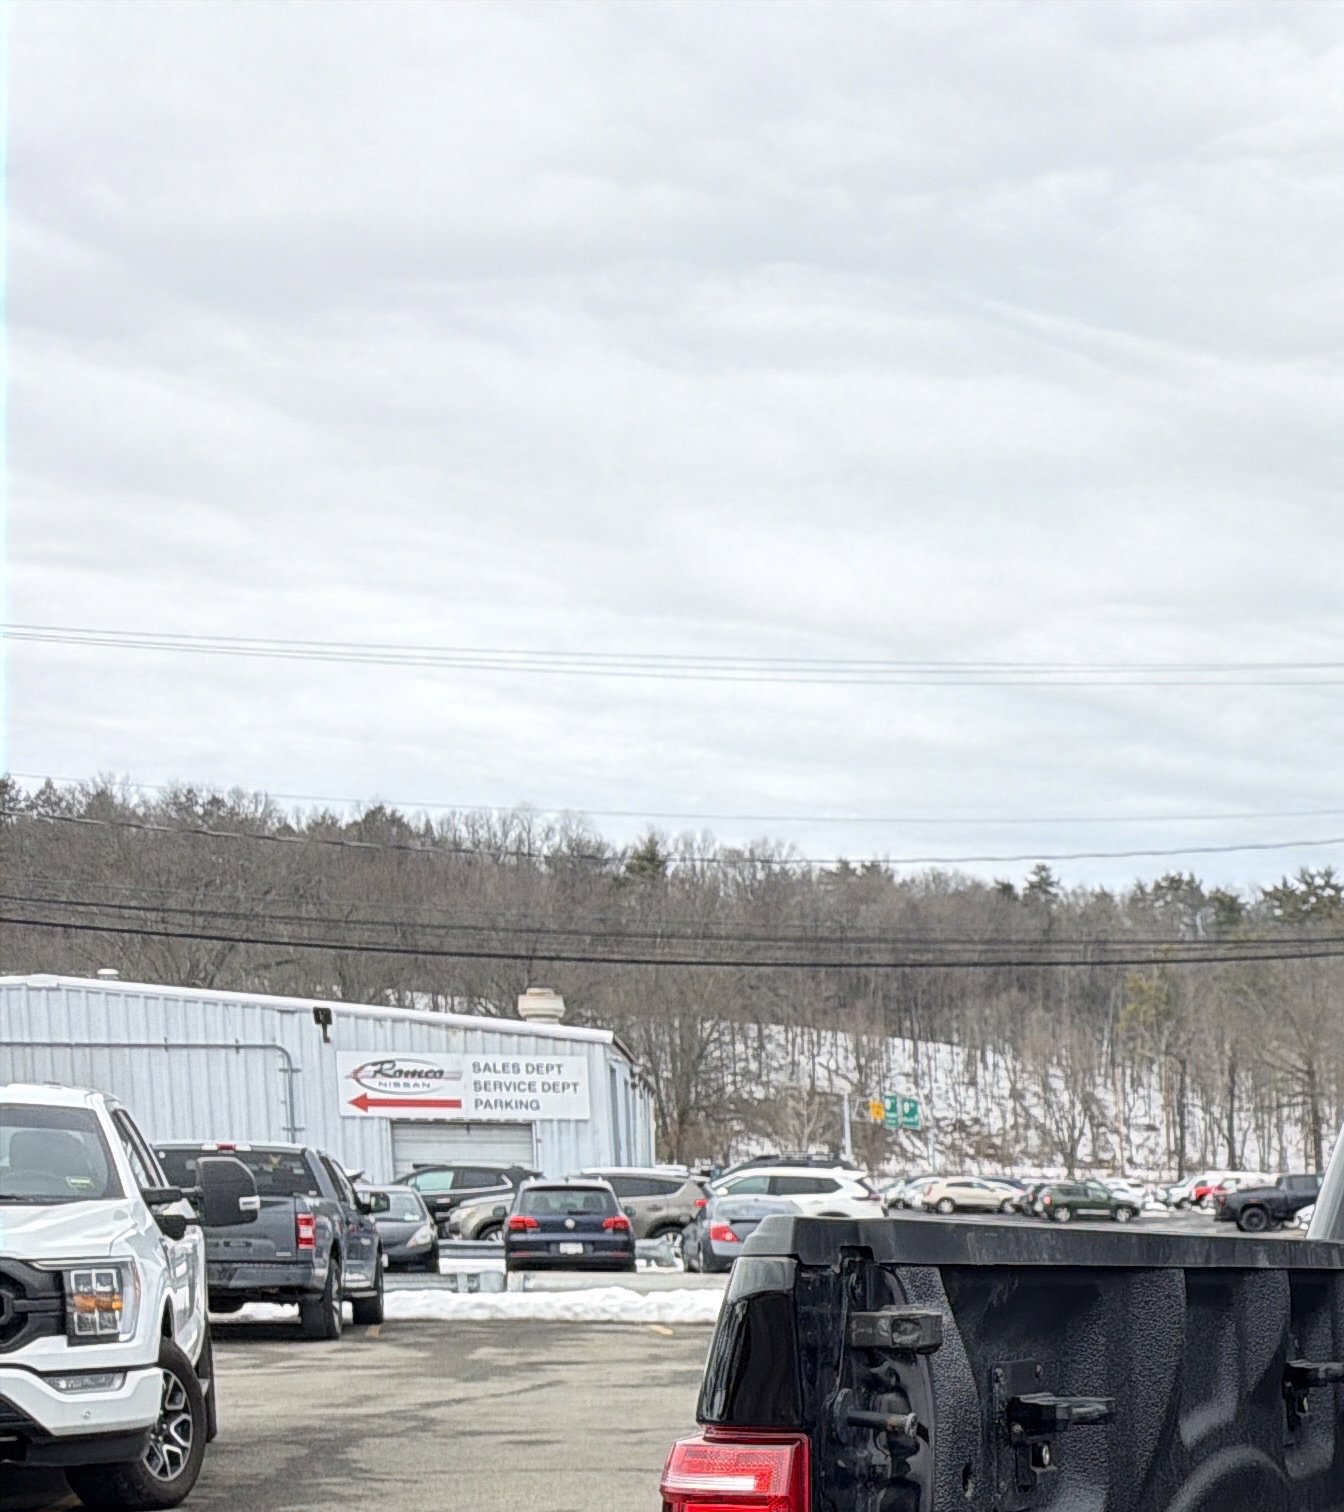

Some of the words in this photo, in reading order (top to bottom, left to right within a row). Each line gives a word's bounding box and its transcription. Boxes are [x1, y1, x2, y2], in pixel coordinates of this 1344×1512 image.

[371, 1059, 445, 1080] Romco
[471, 1061, 521, 1075] SALES
[525, 1062, 564, 1075] DEPT
[378, 1080, 431, 1089] NISSAN
[473, 1079, 537, 1093] SERVICE
[541, 1080, 580, 1093] DEPT
[474, 1097, 541, 1111] PARKING
